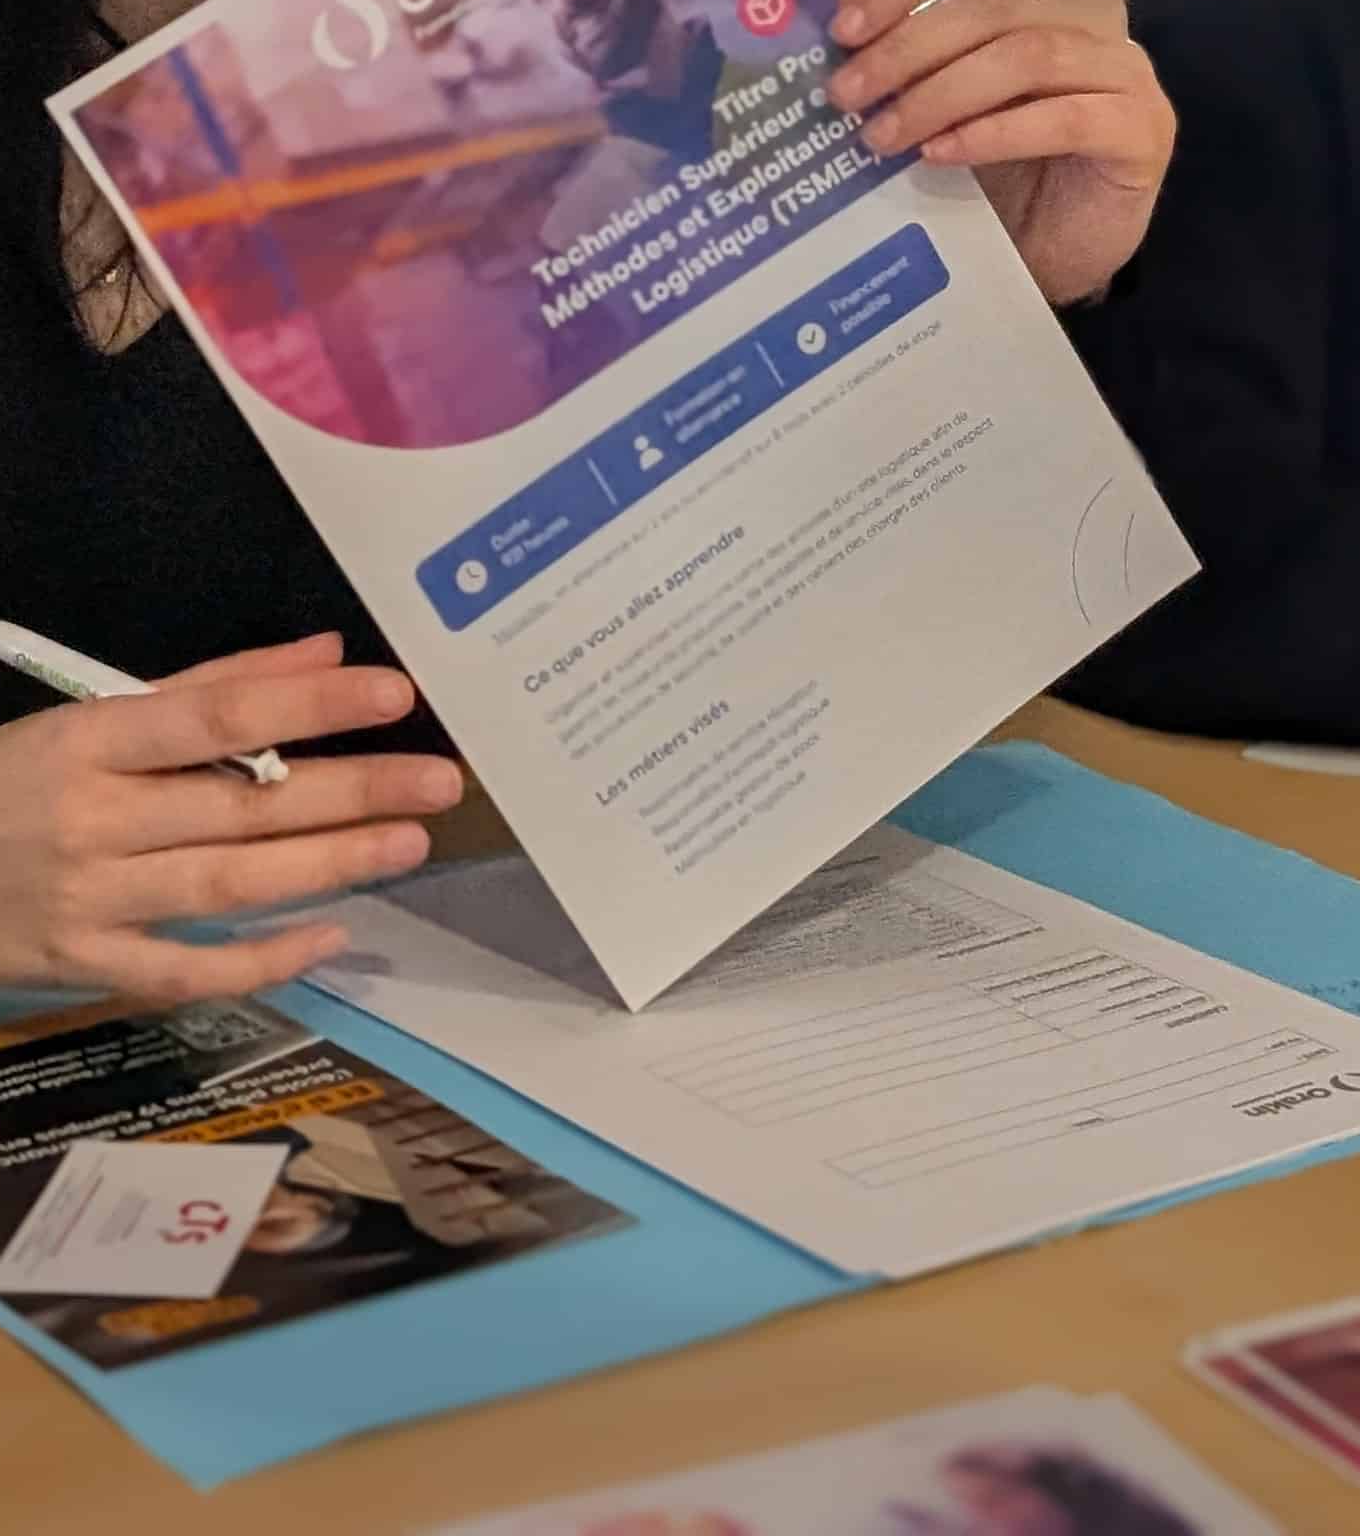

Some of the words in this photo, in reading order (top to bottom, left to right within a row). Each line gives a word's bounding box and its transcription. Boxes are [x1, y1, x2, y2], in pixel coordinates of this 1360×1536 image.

[713, 76, 777, 120] Titre
[778, 45, 824, 81] Pro
[532, 185, 679, 282] Technicien
[680, 100, 802, 189] Supérieur
[542, 231, 676, 326] Méthodes
[678, 207, 708, 237] et
[714, 108, 861, 217] Exploitation
[633, 216, 767, 310] Logistique
[524, 670, 550, 692] Ce
[552, 646, 583, 673] que
[585, 616, 623, 647] vous
[627, 586, 662, 619] allez
[665, 526, 743, 590] apprendre
[595, 778, 627, 805] Les
[629, 732, 687, 779] métiers
[689, 701, 729, 734] visés
[165, 1085, 227, 1107] dans
[271, 1069, 353, 1096] L'école
[1243, 1087, 1332, 1117] Orakin
[35, 1110, 133, 1143] campus
[119, 1119, 153, 1135] en
